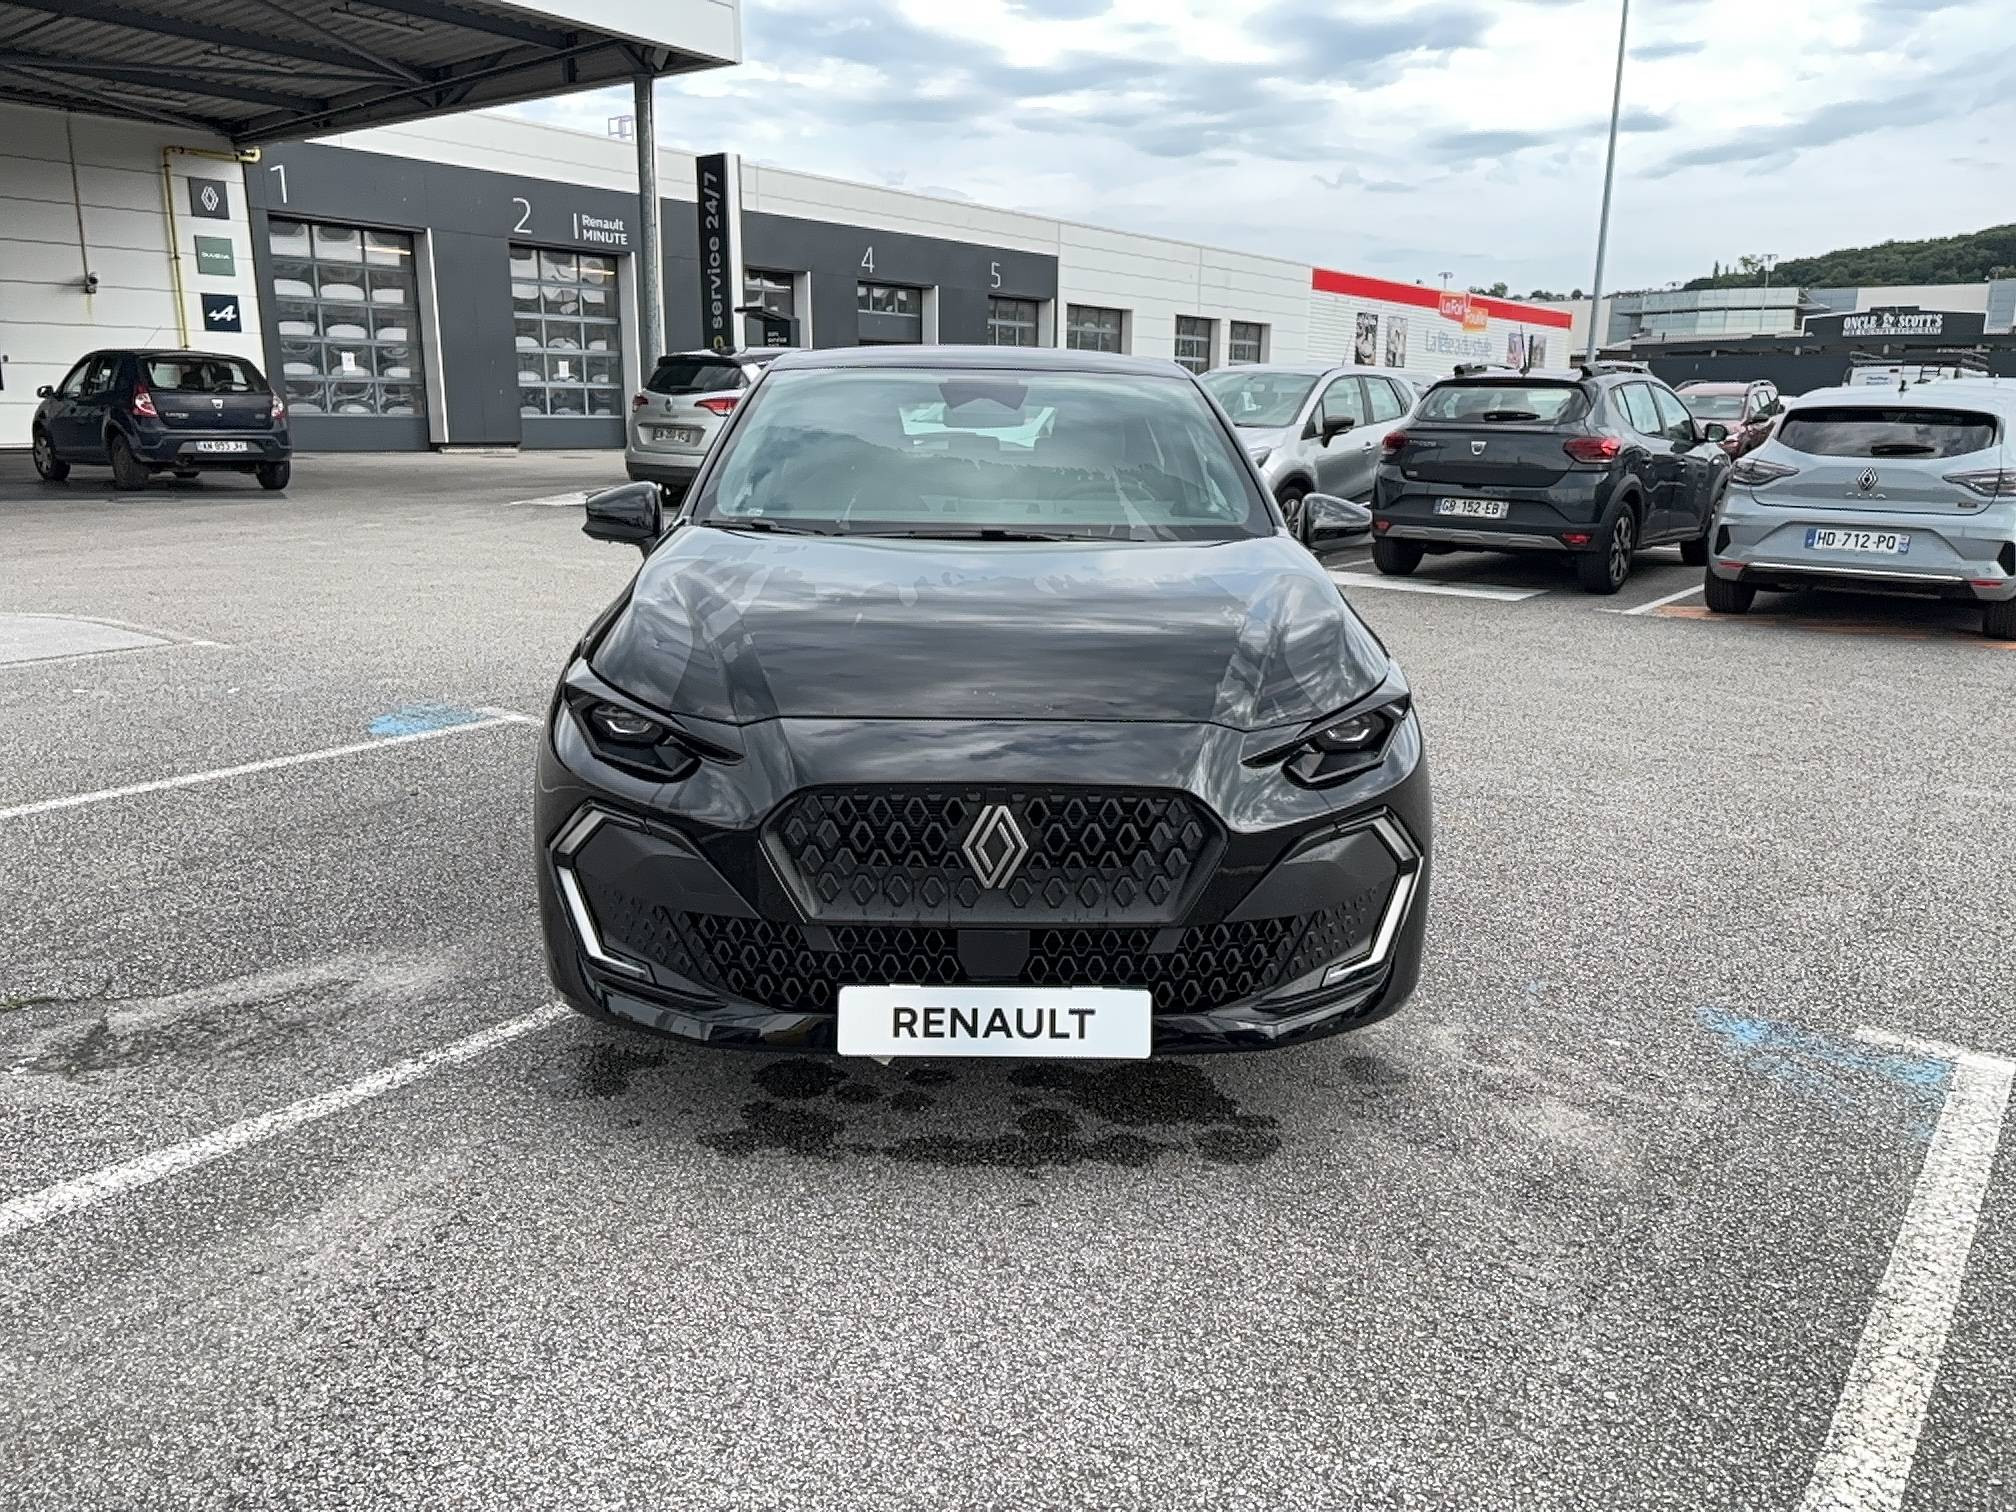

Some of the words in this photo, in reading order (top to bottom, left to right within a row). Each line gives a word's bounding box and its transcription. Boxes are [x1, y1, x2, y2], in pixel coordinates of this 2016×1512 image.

[270, 165, 287, 203] 1
[513, 197, 532, 234] 2
[704, 172, 720, 229] 24/7
[582, 214, 624, 231] Renault
[583, 229, 628, 245] MINUTE
[861, 246, 875, 273] 4
[707, 236, 723, 329] service
[991, 261, 1001, 289] 5
[1843, 315, 1877, 329] ONCLE
[892, 1007, 1096, 1039] RENAULT
